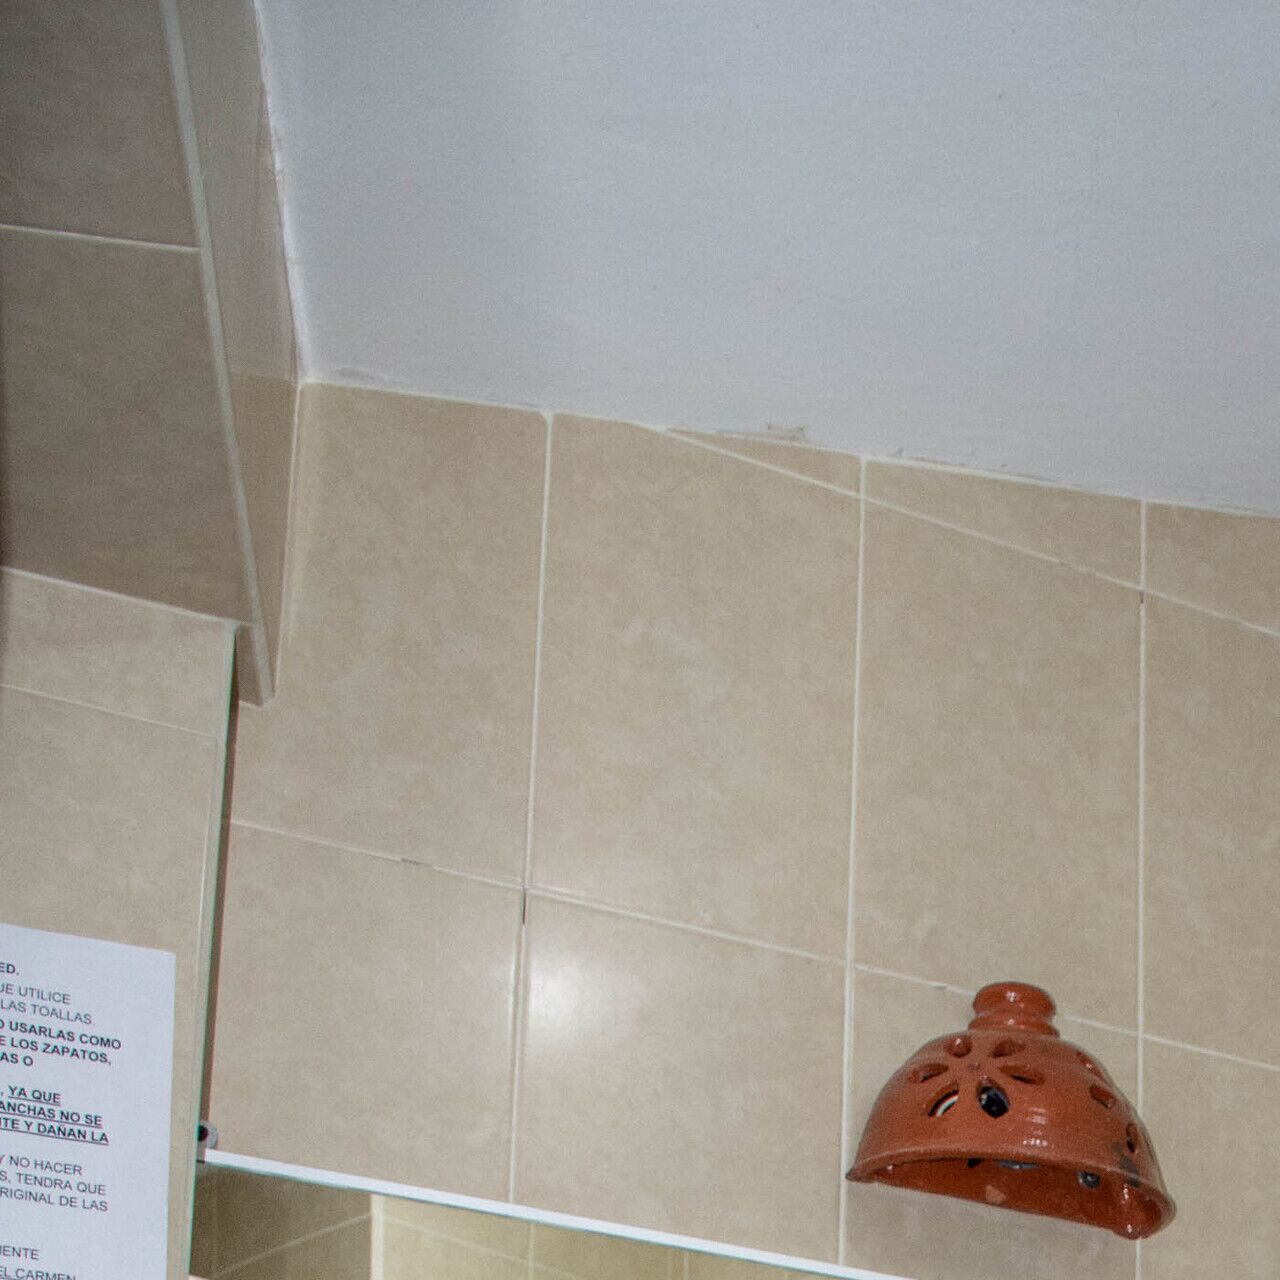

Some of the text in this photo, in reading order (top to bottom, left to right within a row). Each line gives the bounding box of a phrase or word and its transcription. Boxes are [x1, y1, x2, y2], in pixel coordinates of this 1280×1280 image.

[18, 985, 71, 1005] UTILICE
[9, 1021, 75, 1042] USARLAS
[79, 1034, 121, 1050] COMO
[11, 1037, 38, 1051] LOS
[42, 1042, 111, 1066] ZAPATOS,
[8, 1085, 61, 1104] YA QUE
[60, 1110, 80, 1123] NO
[84, 1114, 102, 1127] SE
[24, 1120, 33, 1131] Y
[37, 1123, 87, 1140] DAÑAN
[91, 1131, 109, 1144] LA
[9, 1155, 30, 1168] NO
[34, 1159, 82, 1175] HACER
[16, 1172, 73, 1191] TENDRA
[76, 1182, 106, 1196] QUE
[59, 1195, 78, 1208] DE
[82, 1199, 108, 1212] LAS
